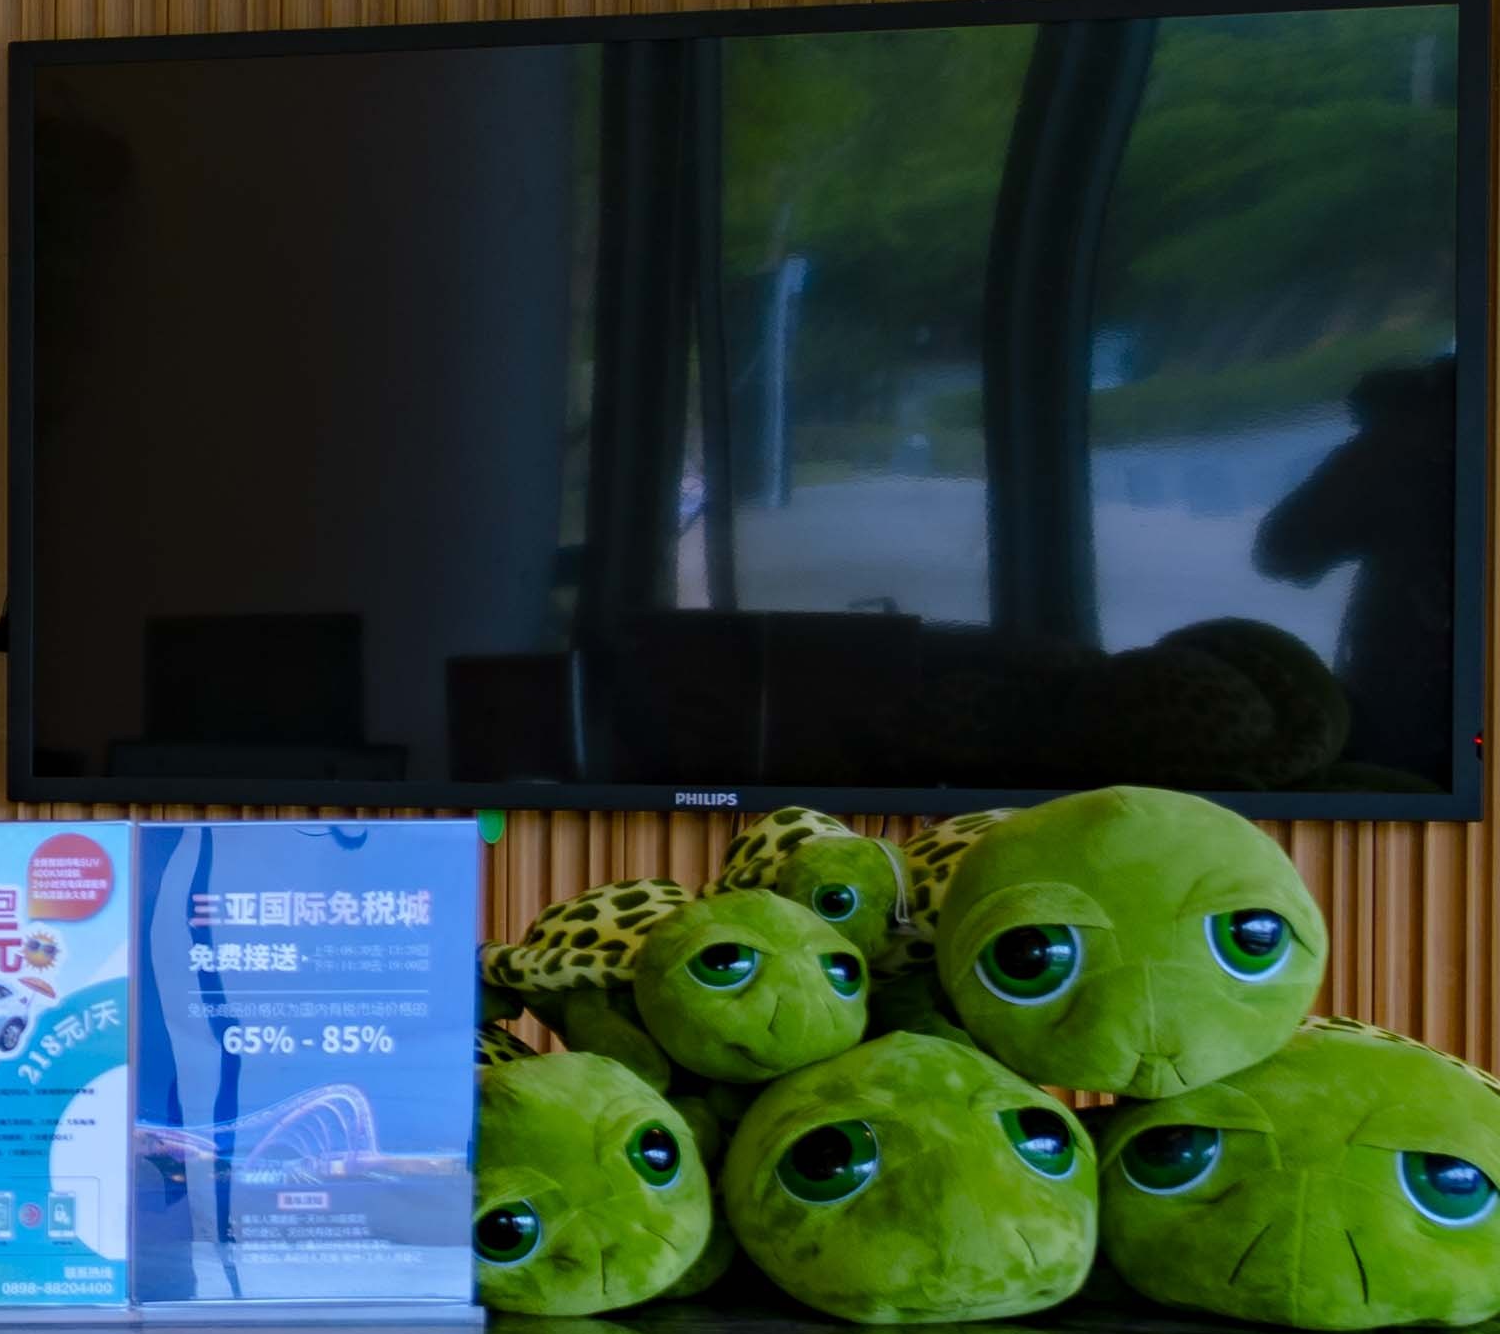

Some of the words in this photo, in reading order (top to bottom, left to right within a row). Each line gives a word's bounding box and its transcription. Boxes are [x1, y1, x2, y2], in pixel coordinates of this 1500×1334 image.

[675, 793, 738, 806] PHILIPS
[188, 889, 433, 928] 三亚国际免税城
[187, 943, 298, 972] 免费接送
[17, 998, 123, 1085] 218元/天
[222, 1025, 295, 1055] 65%
[321, 1024, 394, 1055] 85%
